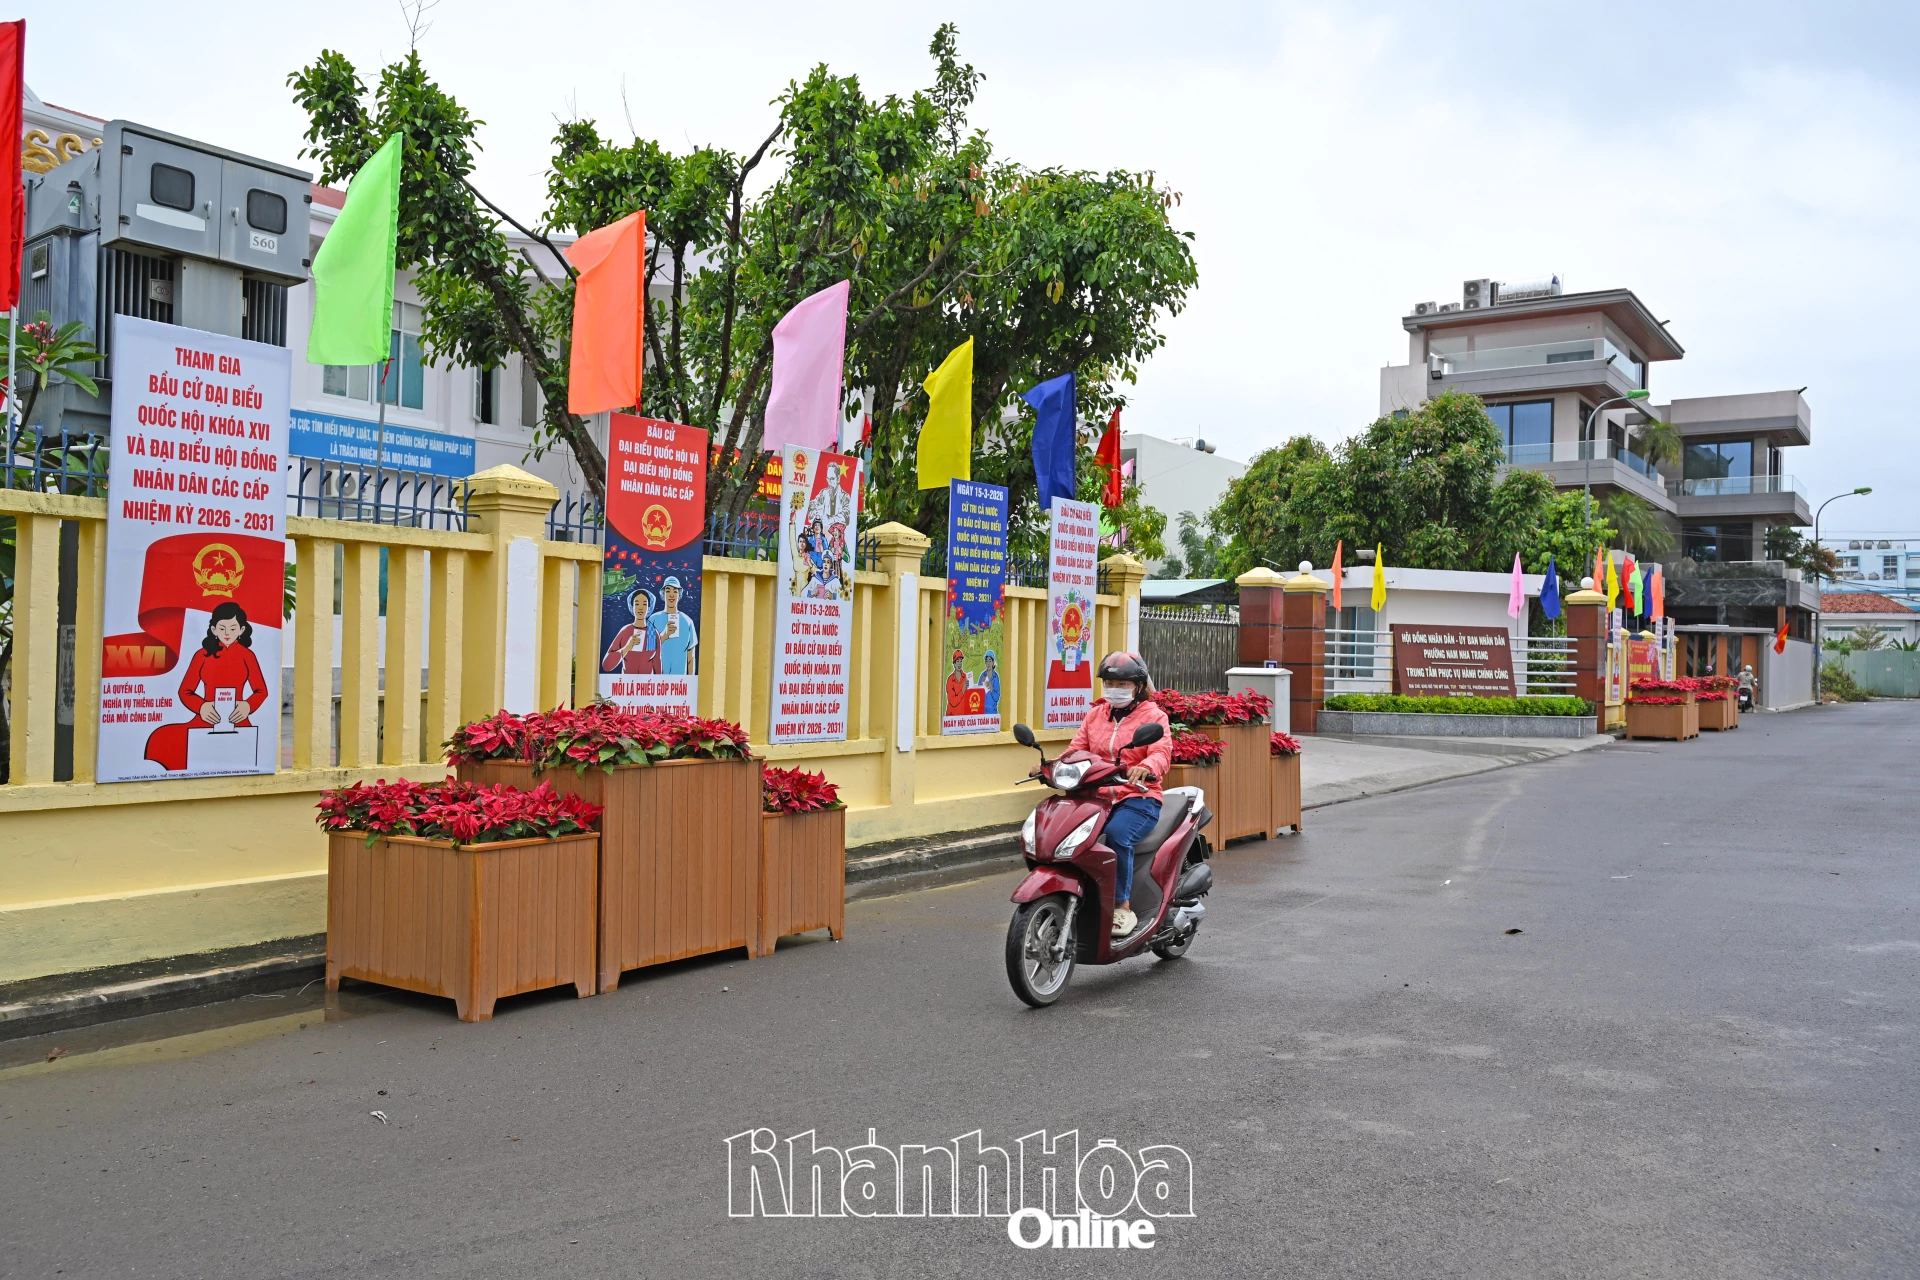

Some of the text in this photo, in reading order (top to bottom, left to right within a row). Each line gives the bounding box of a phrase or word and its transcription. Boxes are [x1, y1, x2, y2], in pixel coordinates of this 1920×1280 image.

[253, 236, 275, 249] 560
[175, 347, 241, 376] THAM GIA
[149, 371, 262, 409] BẦU CỬ ĐẠI BIỂU
[138, 403, 270, 441] QUỐC HỘI KHÓA XVI
[665, 427, 675, 441] CỬ
[127, 434, 277, 472] VÀ ĐẠI BIỂU HỘI ĐỒNG
[619, 440, 698, 464] ĐẠI BIỂU QUỐC HỘI VÀ
[624, 460, 636, 475] ĐẠI
[639, 460, 656, 476] BIỂU
[659, 466, 671, 480] HỘI
[794, 472, 806, 482] XVI
[133, 468, 269, 500] NHÂN DÂN CÁC CẤP
[621, 479, 694, 500] NHÂN DÂN CÁC CẤP
[957, 484, 1003, 501] NGÀY 15-3-2026
[123, 500, 171, 525] NHIỆM
[176, 503, 194, 524] KỲ
[198, 508, 231, 527] 2026
[244, 513, 274, 531] 2031
[791, 601, 808, 615] NGÀY
[792, 620, 838, 636] CỬ TRI CẢ NƯỚC
[105, 645, 166, 669] XVI
[785, 643, 792, 654] ĐI
[808, 640, 816, 655] CỬ
[817, 643, 827, 658] ĐẠI
[829, 640, 842, 656] BIỂU
[784, 659, 841, 677] QUỐC HỘI KHÓA XVI
[103, 683, 111, 694] LÀ
[134, 684, 145, 695] LỢI,
[612, 678, 624, 696] MỖI
[627, 680, 634, 696] LÁ
[636, 679, 655, 696] PHIẾU
[657, 680, 669, 696] GÓP
[780, 681, 787, 695] VÀ
[789, 684, 799, 697] ĐẠI
[801, 679, 815, 695] BIỂU
[816, 682, 826, 697] HỘI
[103, 697, 172, 710] NGHĨA VỤ THIÊNG LIÊNG
[782, 699, 840, 715] NHÂN DÂN CÁC CẤP
[102, 710, 162, 723] CỦA MỖI CÔNG DÂN!
[776, 721, 843, 737] NHIỆM KỲ 2026 2031!
